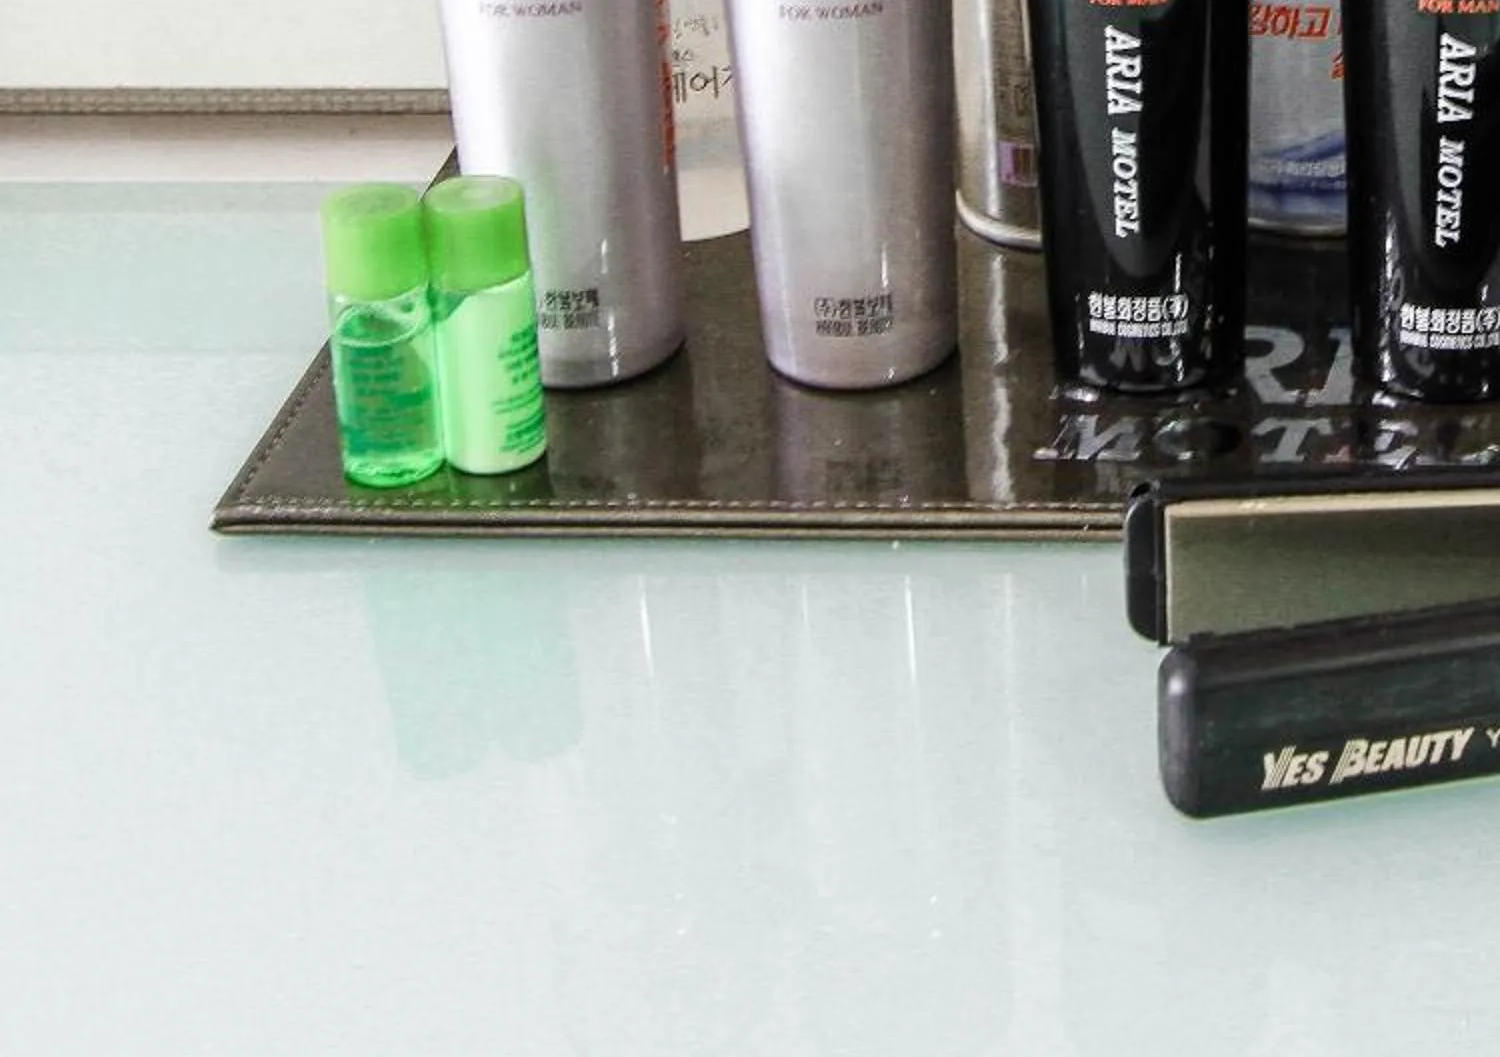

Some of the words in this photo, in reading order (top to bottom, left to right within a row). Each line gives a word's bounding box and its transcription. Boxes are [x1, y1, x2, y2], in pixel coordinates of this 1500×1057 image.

[513, 0, 583, 17] WOMAN
[815, 1, 884, 20] WOMAN
[1104, 24, 1143, 115] ARIA
[1437, 32, 1477, 123] ARIA
[1111, 127, 1140, 238] MOTEL
[1435, 134, 1465, 248] MOTEL
